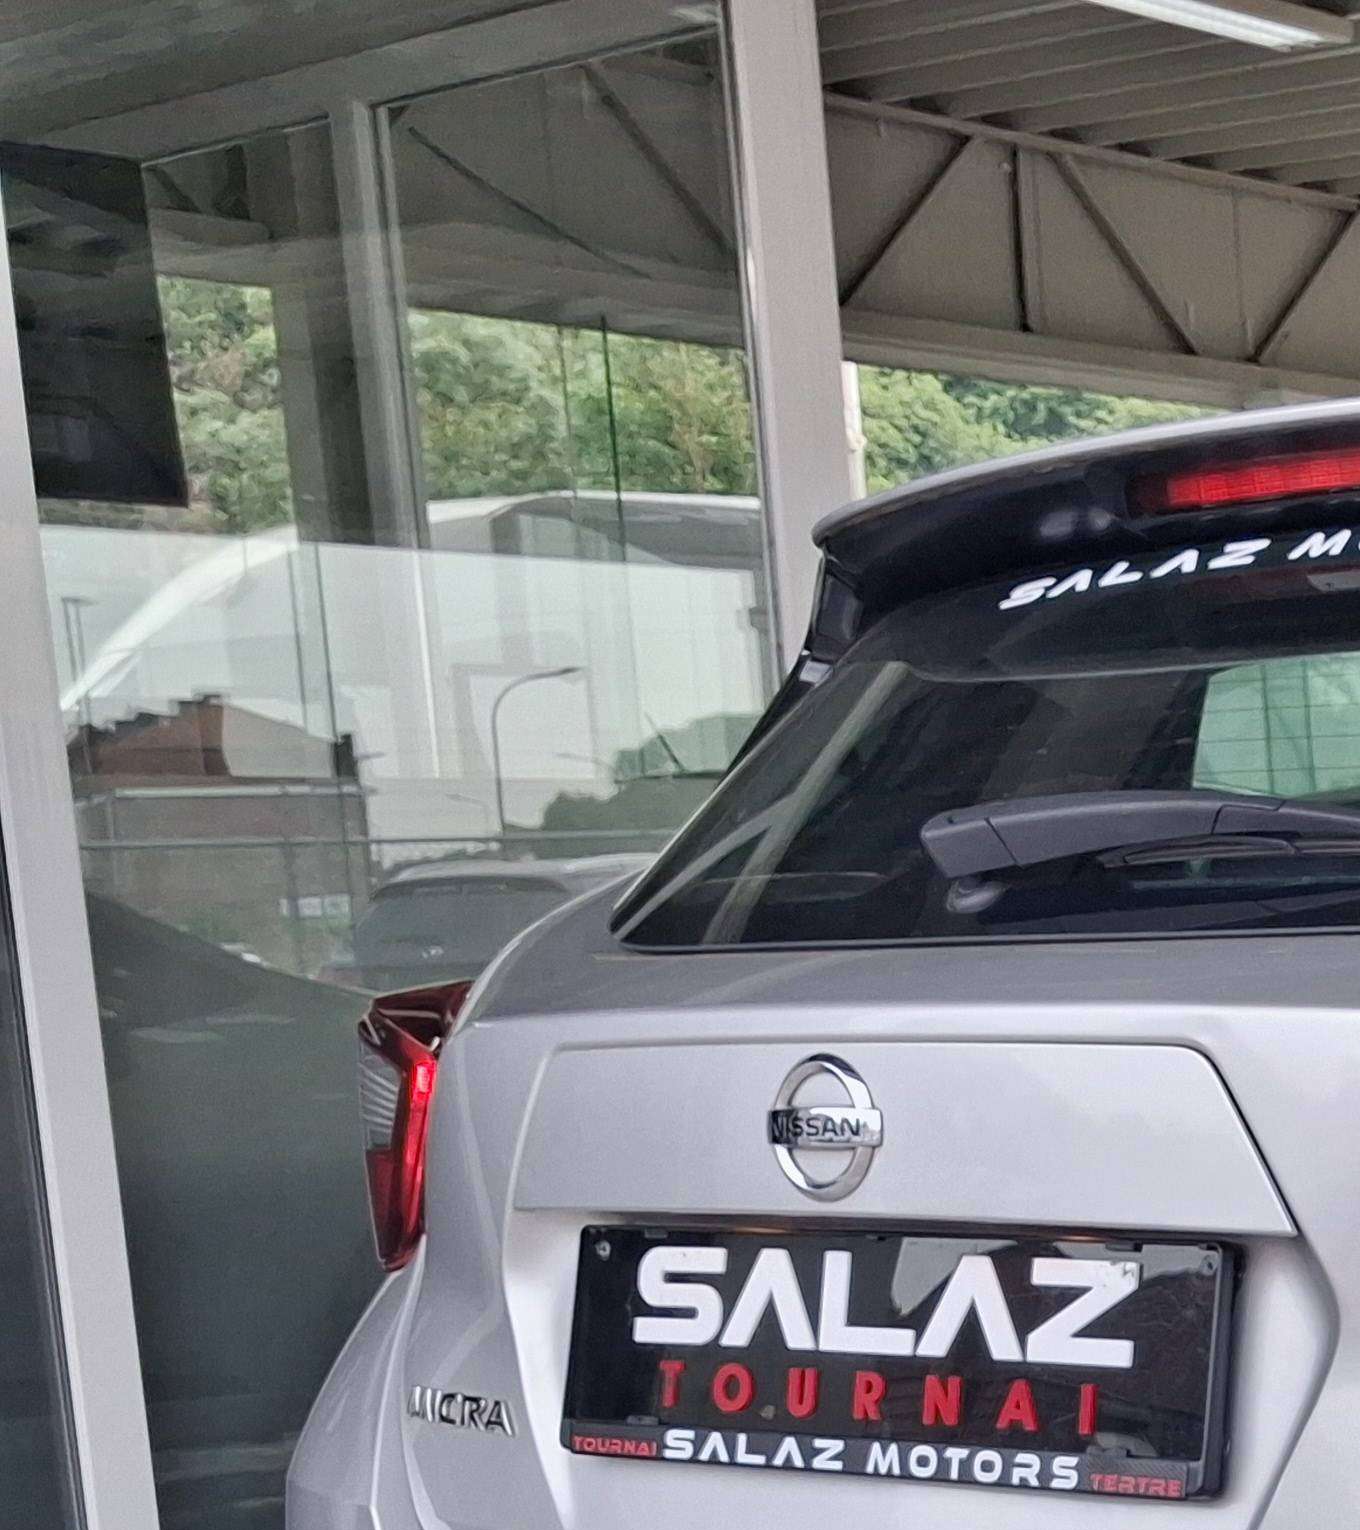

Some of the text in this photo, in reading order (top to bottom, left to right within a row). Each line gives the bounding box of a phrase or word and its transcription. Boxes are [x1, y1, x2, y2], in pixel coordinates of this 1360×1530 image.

[998, 537, 1272, 611] SALAZ
[770, 1112, 861, 1138] NISSAN
[632, 1245, 1141, 1369] SALAZ
[658, 1359, 1099, 1436] TOURNAI
[572, 1427, 1184, 1498] TOURNAI SALAZ MOTORS TERTRE
